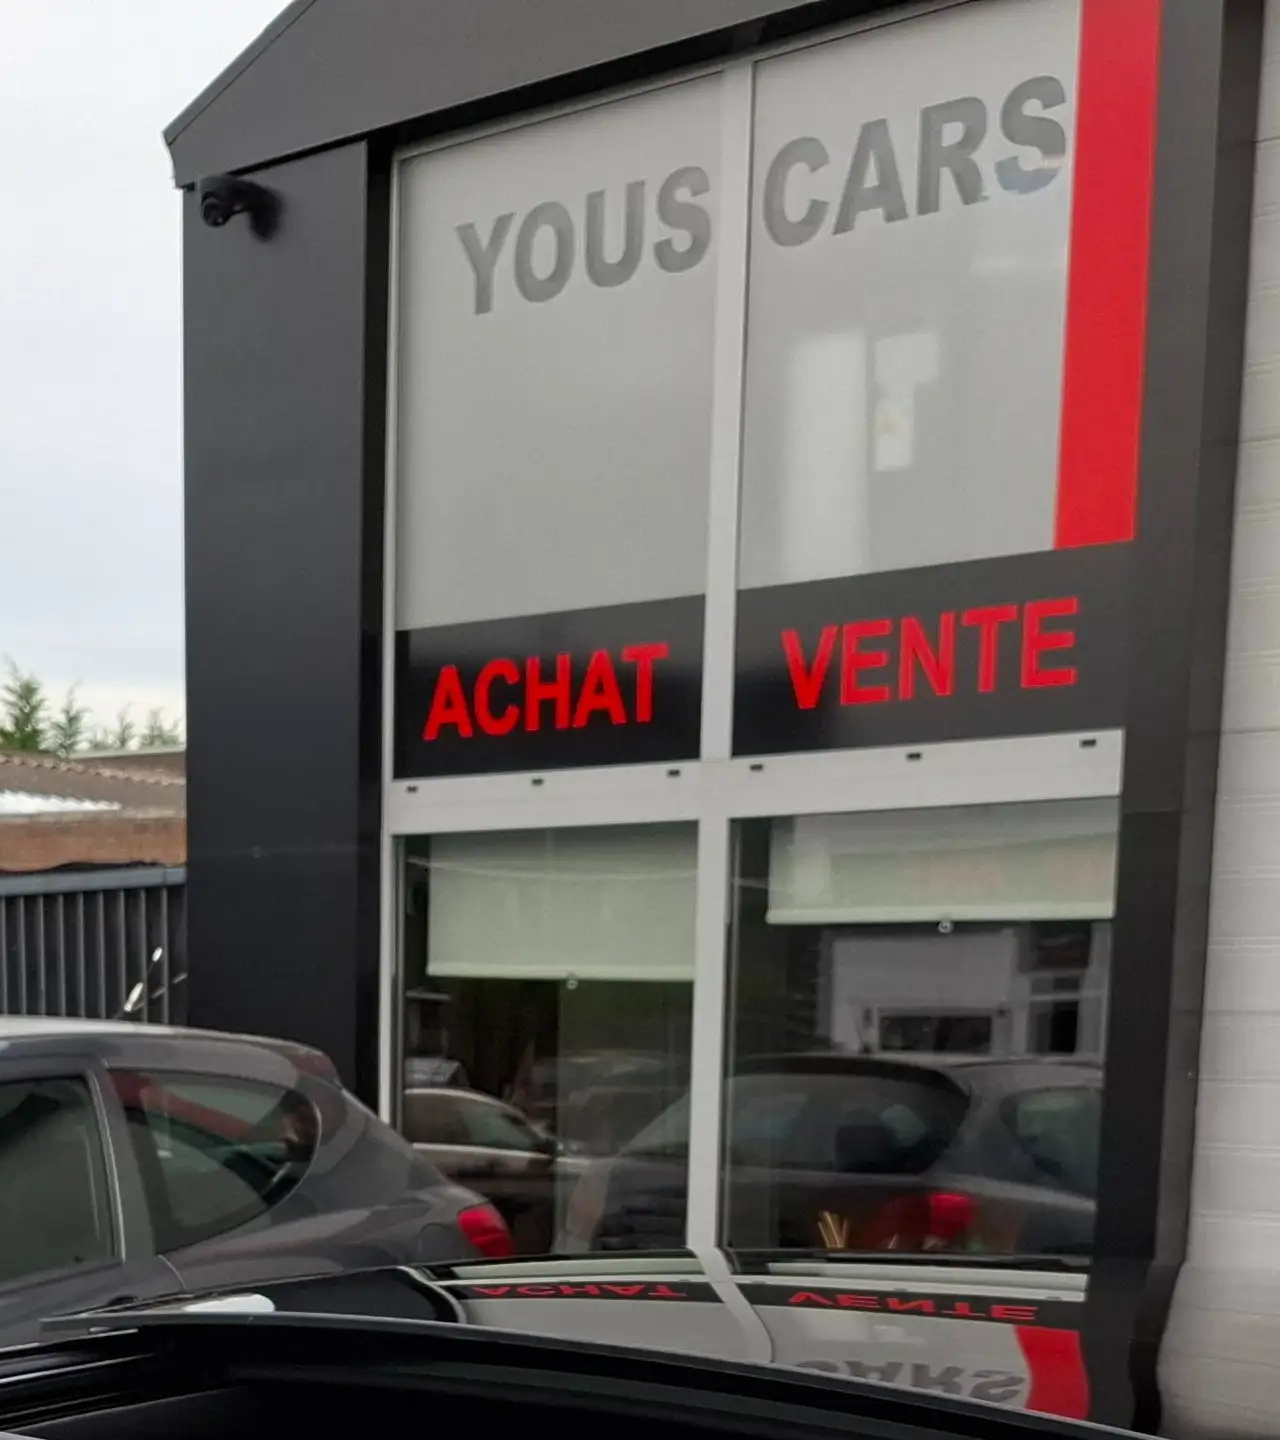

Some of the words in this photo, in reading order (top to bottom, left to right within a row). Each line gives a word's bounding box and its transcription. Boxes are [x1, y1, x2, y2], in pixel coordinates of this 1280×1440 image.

[454, 166, 711, 315] YOUS
[762, 75, 1066, 247] CARS
[423, 643, 670, 742] ACHAT
[781, 598, 1080, 711] VENTE
